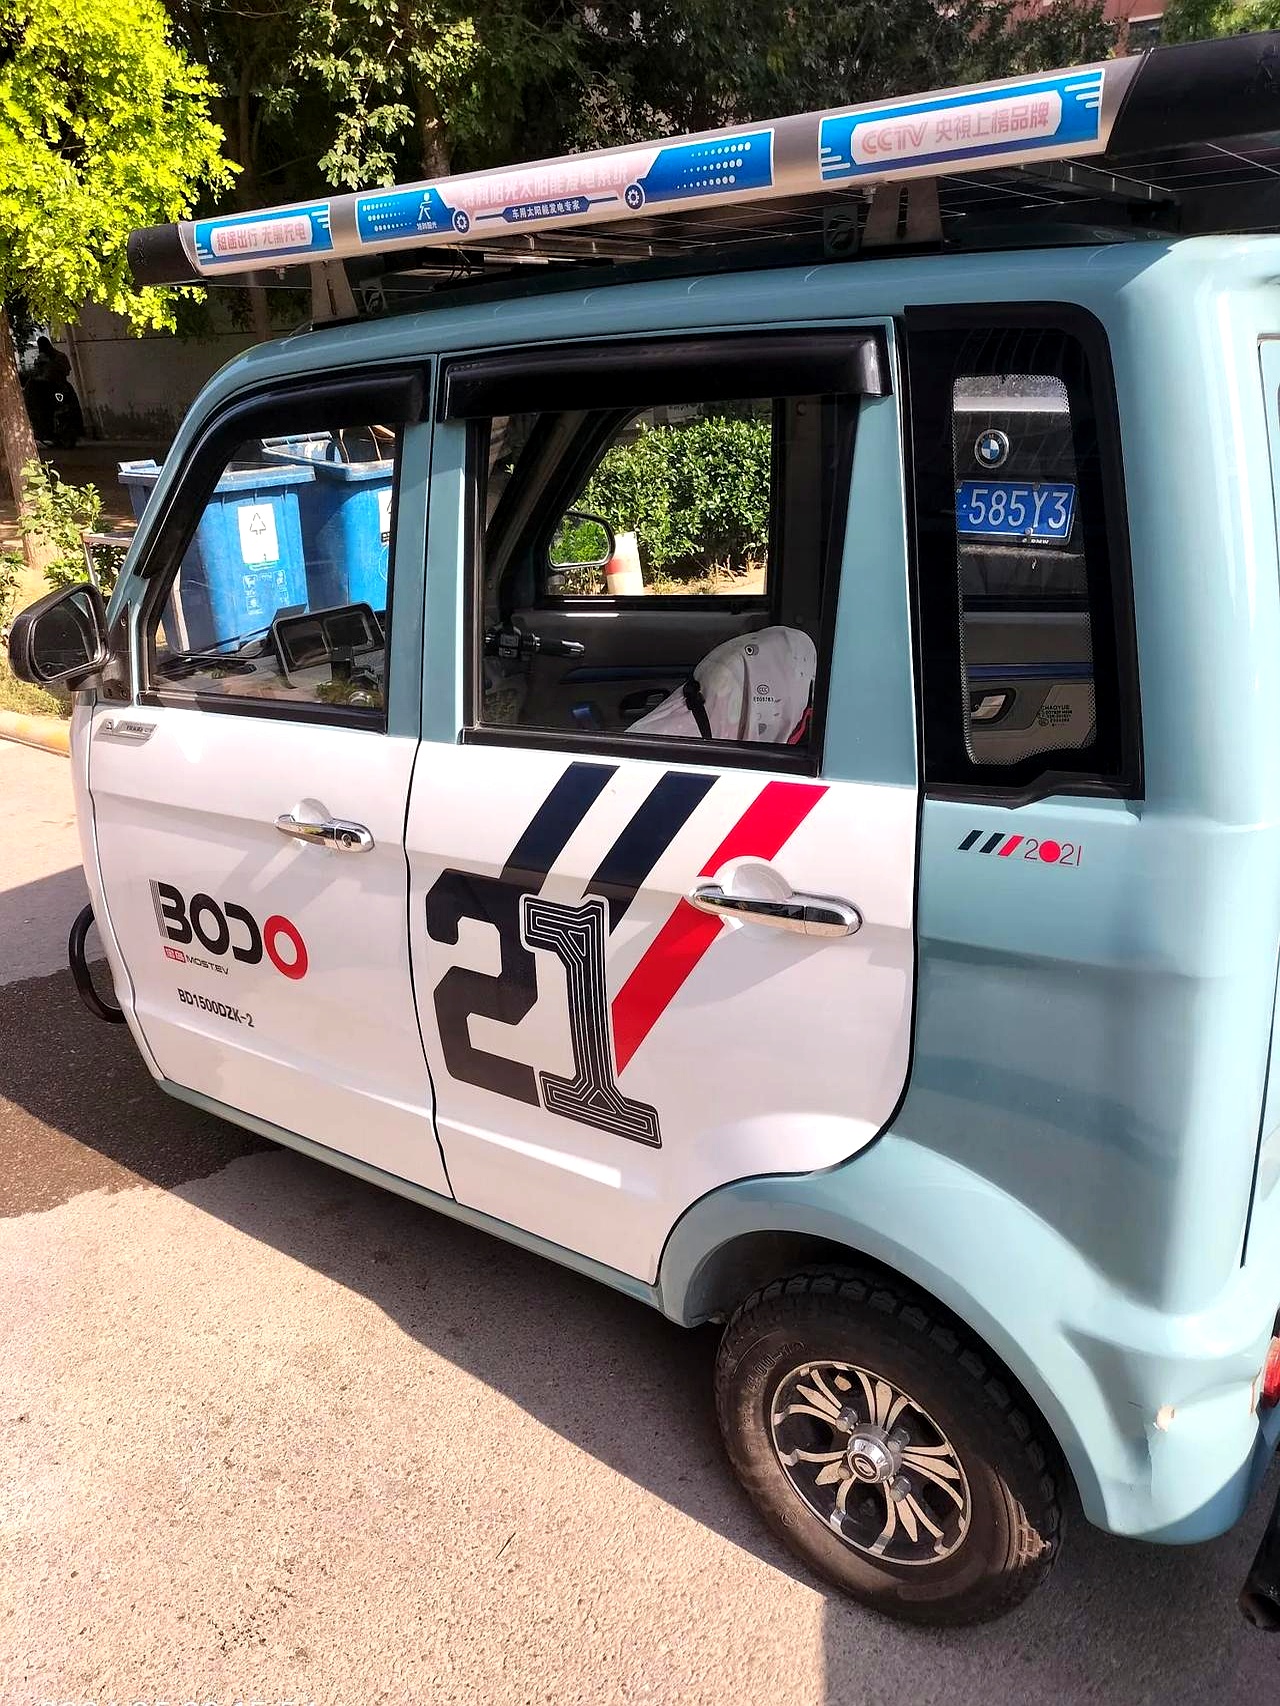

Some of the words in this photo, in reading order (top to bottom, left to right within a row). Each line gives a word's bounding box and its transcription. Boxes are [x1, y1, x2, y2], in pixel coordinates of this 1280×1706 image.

[861, 121, 929, 155] CCTV
[1024, 838, 1082, 866] 2021
[185, 954, 229, 975] MOSTEV
[177, 987, 255, 1028] BD1500DZK-2
[425, 867, 663, 1150] 21
